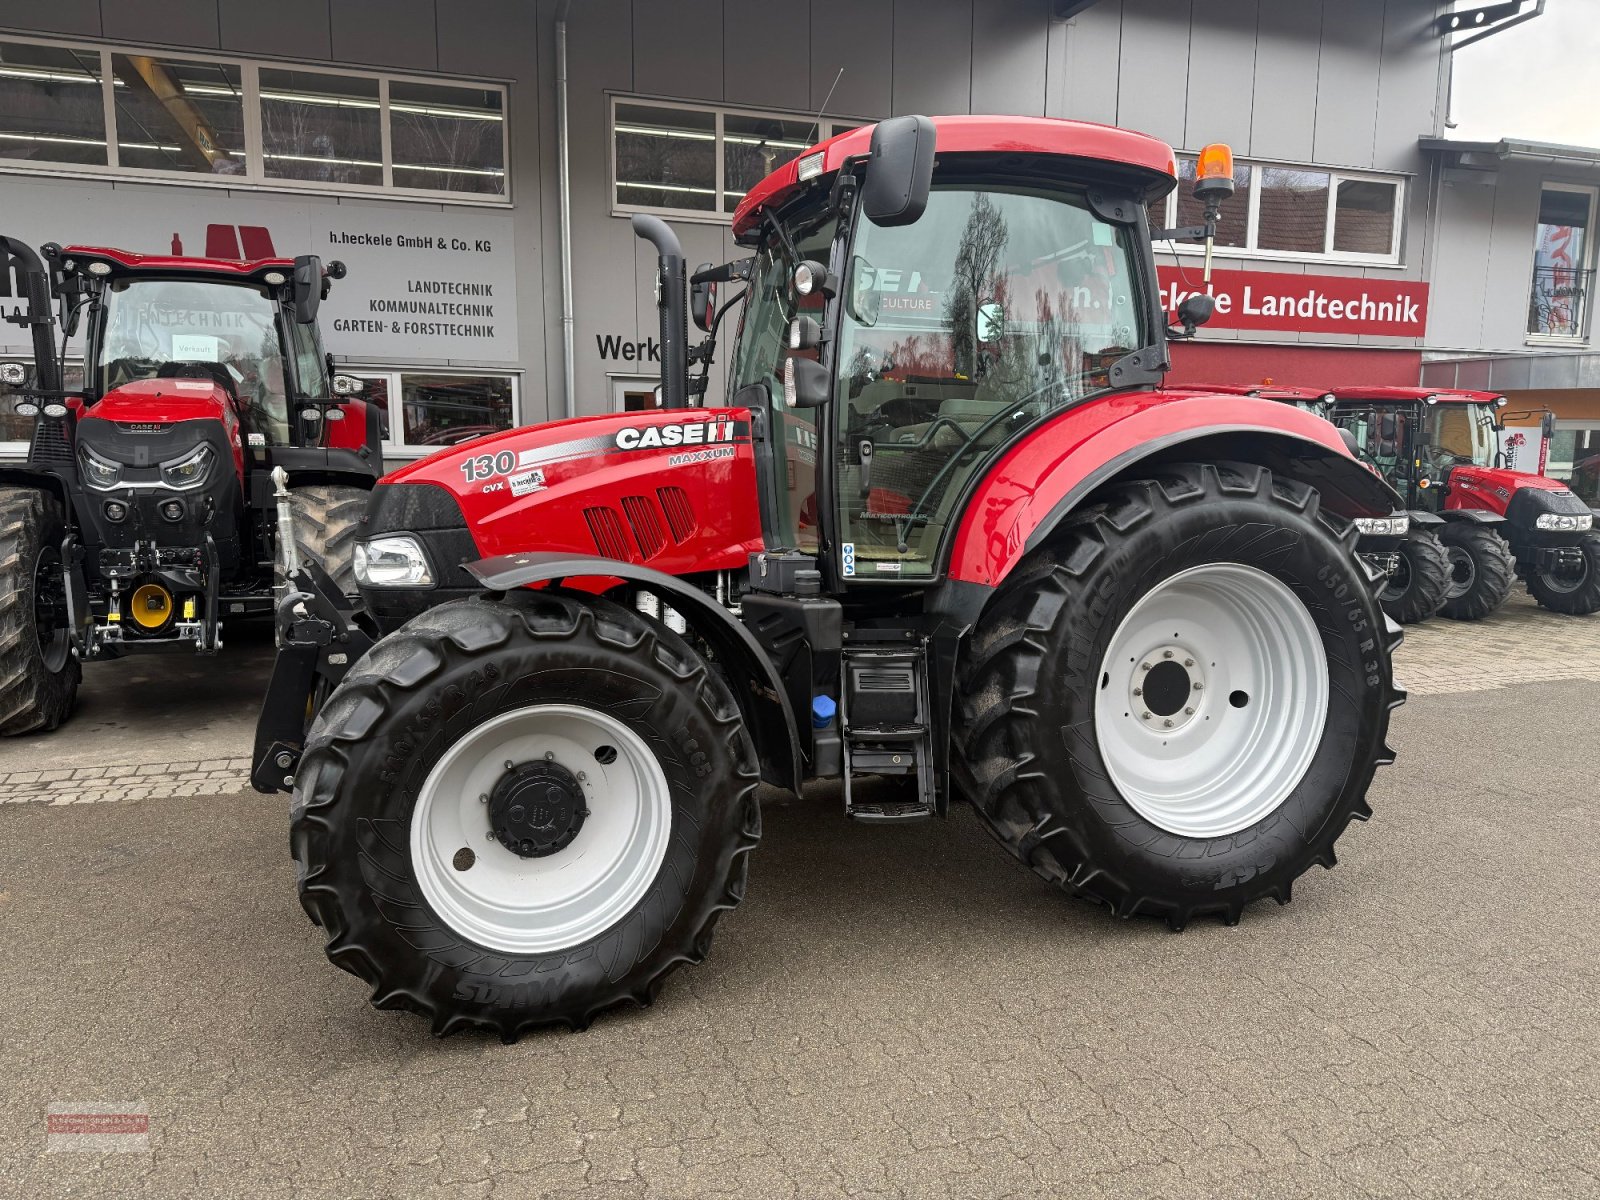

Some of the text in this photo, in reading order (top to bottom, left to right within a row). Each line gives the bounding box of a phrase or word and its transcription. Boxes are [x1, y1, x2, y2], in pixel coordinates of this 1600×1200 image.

[330, 231, 491, 252] h.heckele GmbH & Co. KG
[408, 280, 493, 297] LANDTECHNIK
[369, 300, 494, 317] KOMMUNALTECHNIK
[1242, 286, 1419, 323] Landtechnik
[333, 319, 494, 338] GARTEN- & FORSTTECHNIK
[179, 345, 211, 353] Verkauft
[616, 424, 704, 449] CASE
[460, 450, 516, 482] 130
[669, 447, 734, 466] MAXXUM
[483, 482, 504, 494] CVX
[1317, 564, 1380, 687] 650/65 R 38
